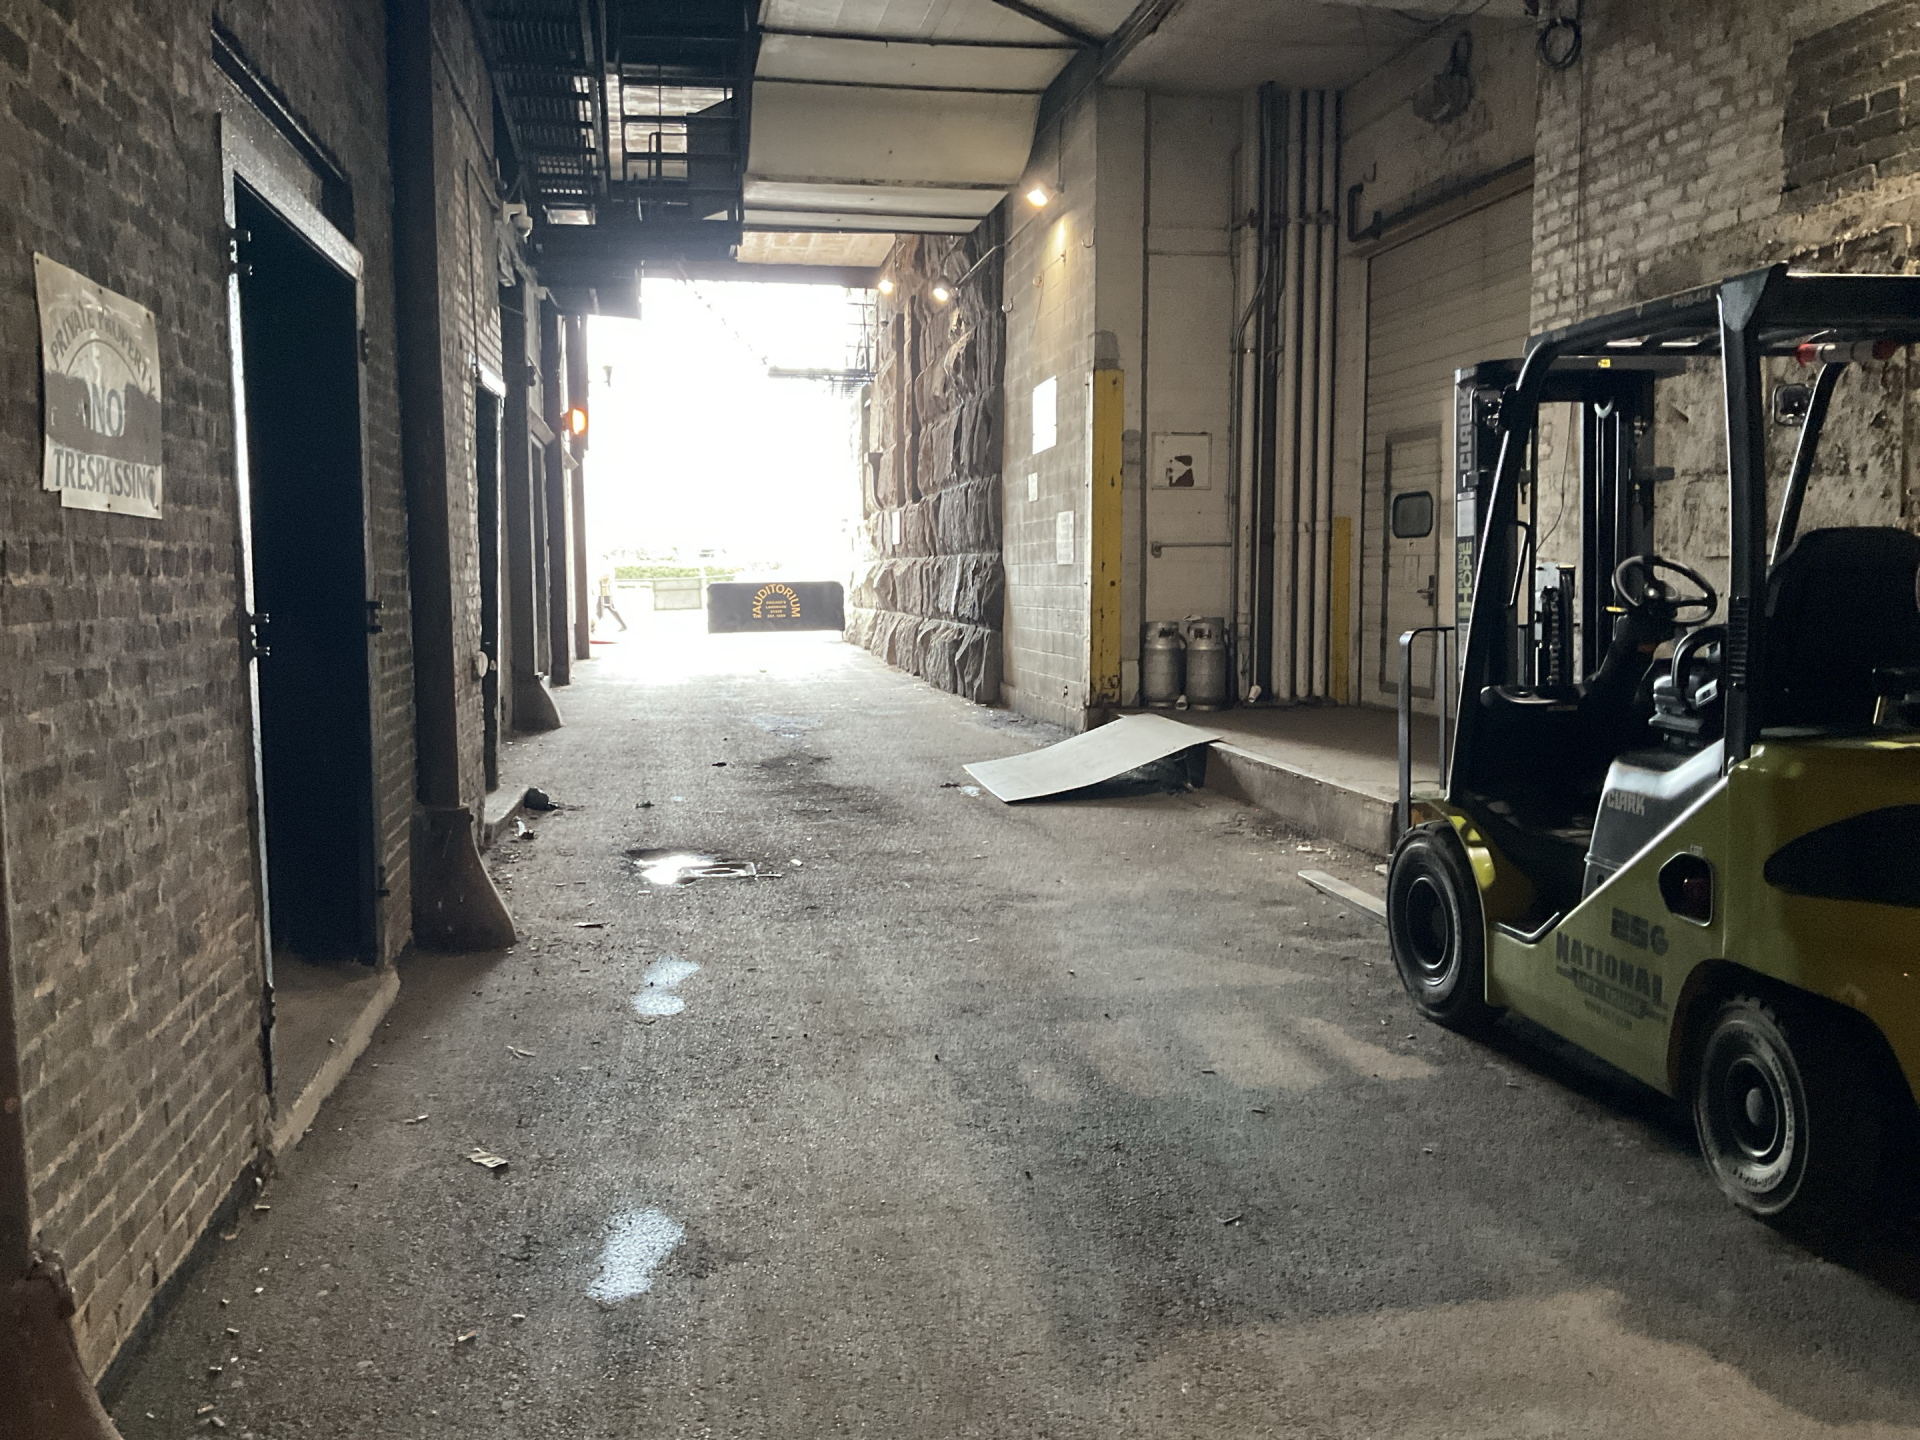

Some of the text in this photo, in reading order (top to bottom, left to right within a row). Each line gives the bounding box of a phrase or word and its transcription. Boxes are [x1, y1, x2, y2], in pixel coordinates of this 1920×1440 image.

[50, 301, 95, 368] PRIVATE
[91, 384, 124, 437] NO
[53, 448, 156, 501] TRESPASSING
[752, 584, 800, 617] AUDITORIUM
[1458, 541, 1473, 608] HOPE
[1606, 791, 1645, 816] CLARK
[1556, 931, 1668, 1010] NATIONAL
